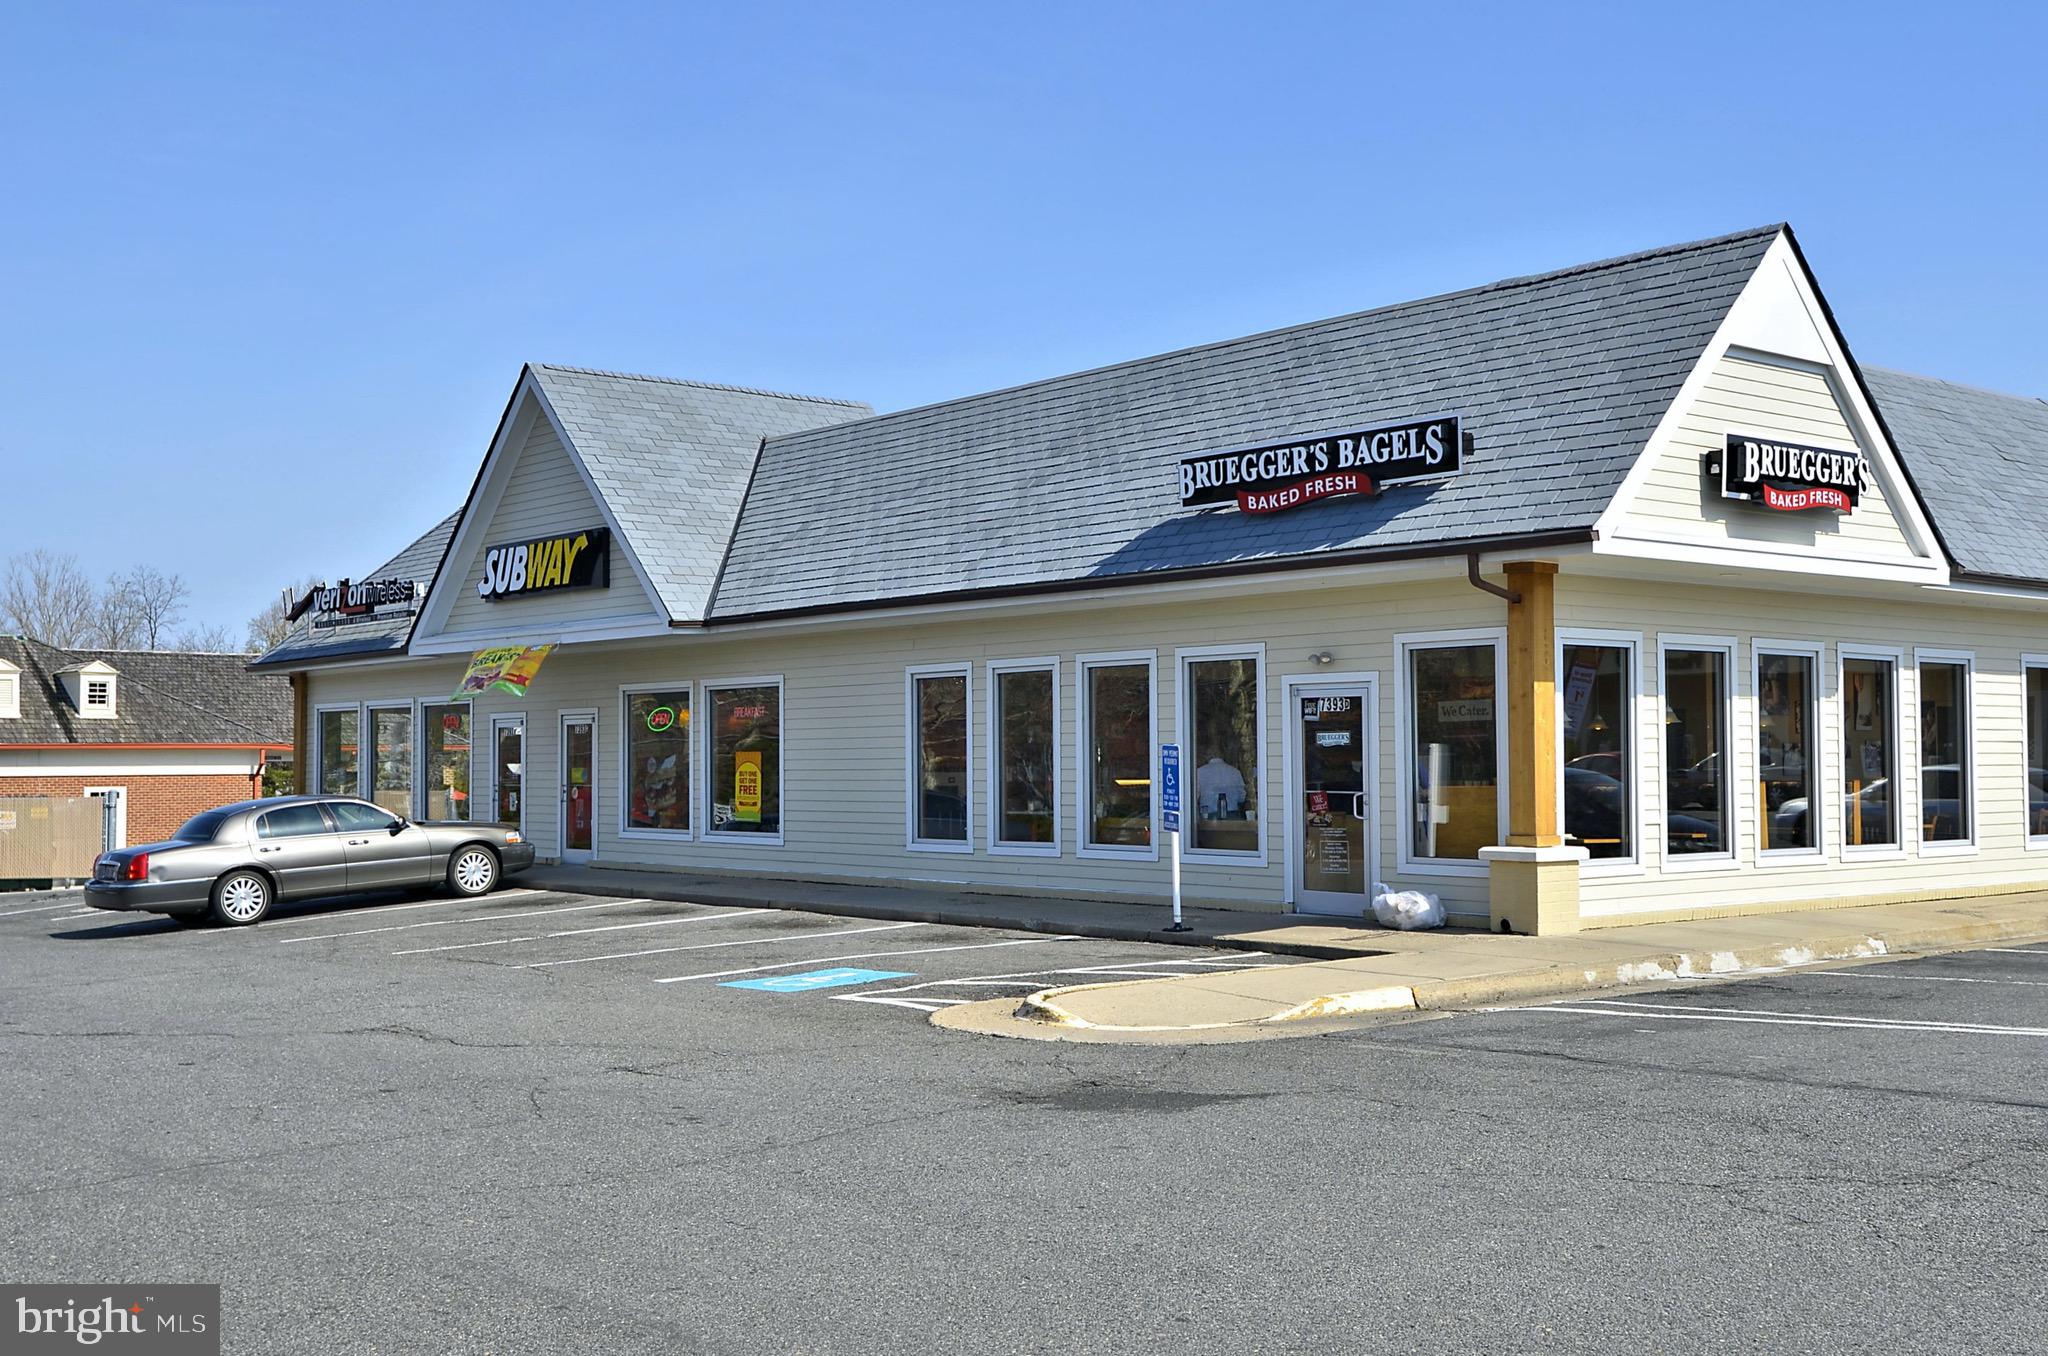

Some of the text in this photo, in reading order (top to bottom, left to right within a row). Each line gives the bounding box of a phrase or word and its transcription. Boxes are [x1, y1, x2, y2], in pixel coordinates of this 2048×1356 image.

[1178, 424, 1443, 500] BRUEGGER'S BAGELS
[1743, 441, 1870, 497] BRUEGGER'S
[1248, 476, 1357, 510] BAKED FRESH
[1770, 491, 1842, 507] BAKED FRESH
[477, 532, 588, 596] SUBWAY
[652, 712, 671, 726] OPEN
[1441, 705, 1457, 717] We
[739, 785, 758, 795] FREE
